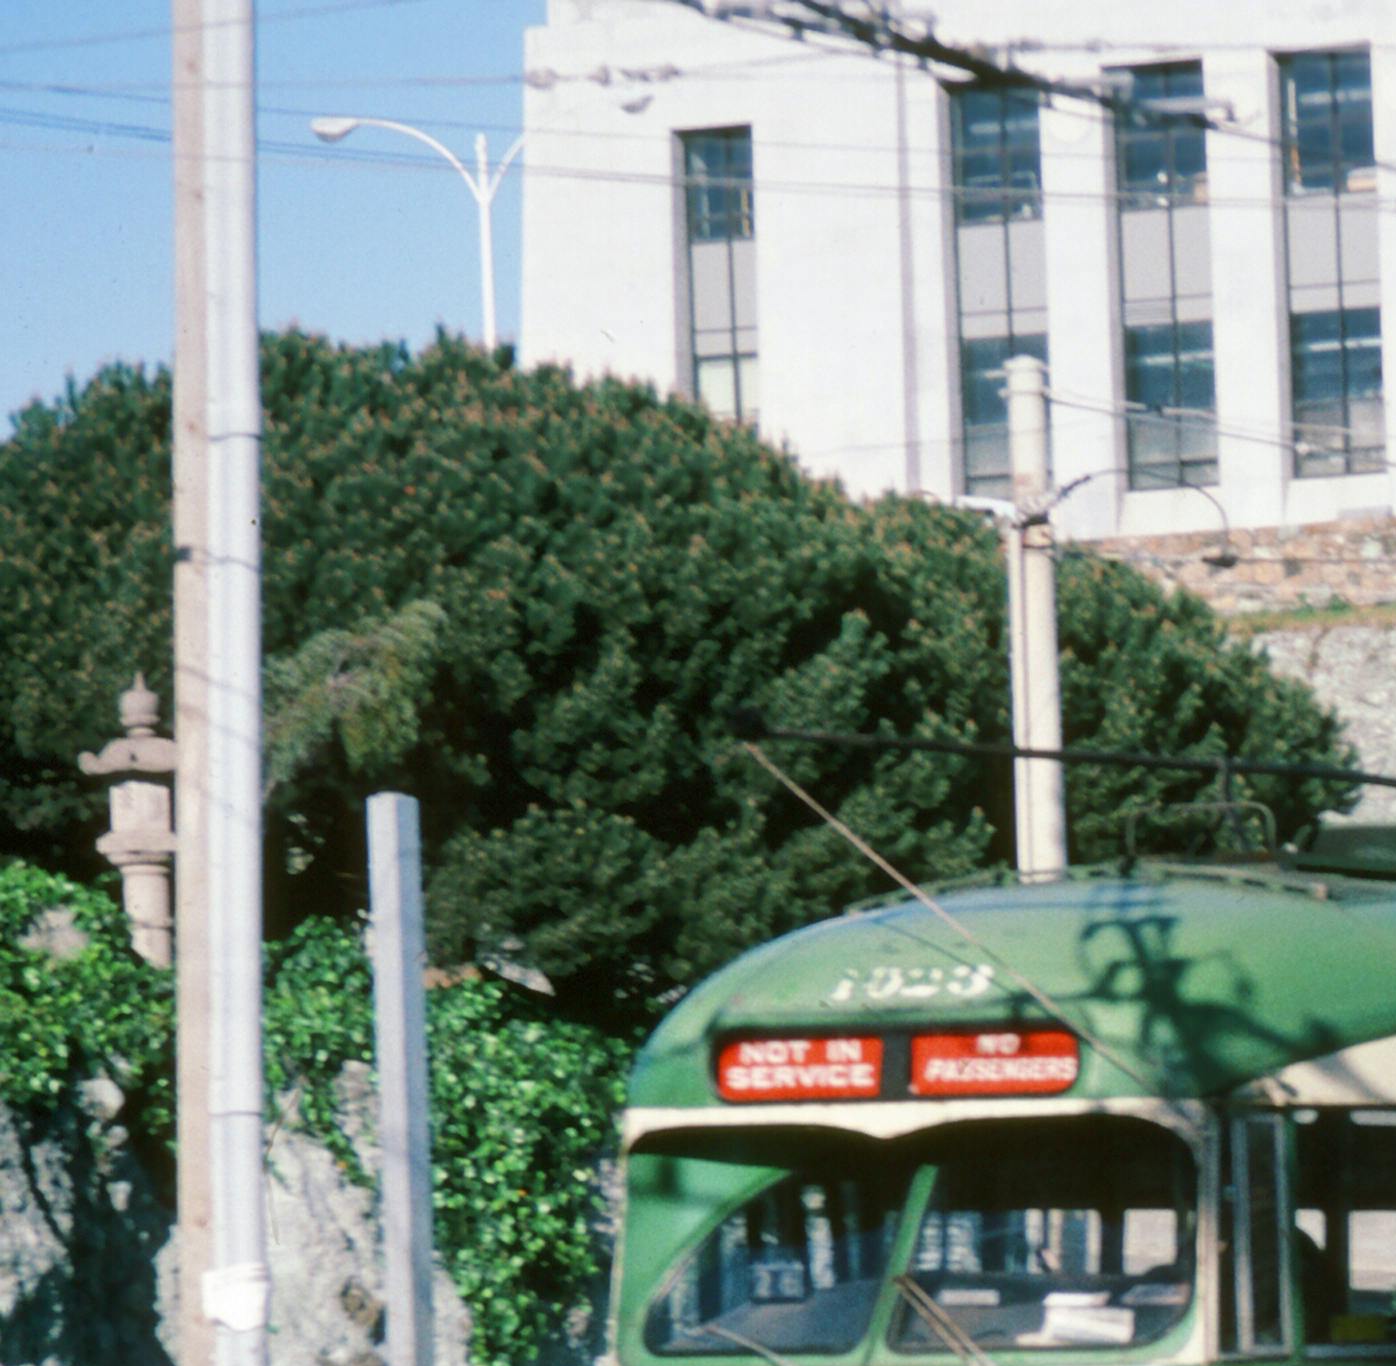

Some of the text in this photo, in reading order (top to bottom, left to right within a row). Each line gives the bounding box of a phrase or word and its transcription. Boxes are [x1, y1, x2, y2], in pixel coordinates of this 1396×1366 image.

[740, 1038, 862, 1063] NOT IN
[976, 1033, 1020, 1053] NO
[726, 1062, 875, 1089] SERVICE
[925, 1057, 1077, 1082] PASSENGERS
